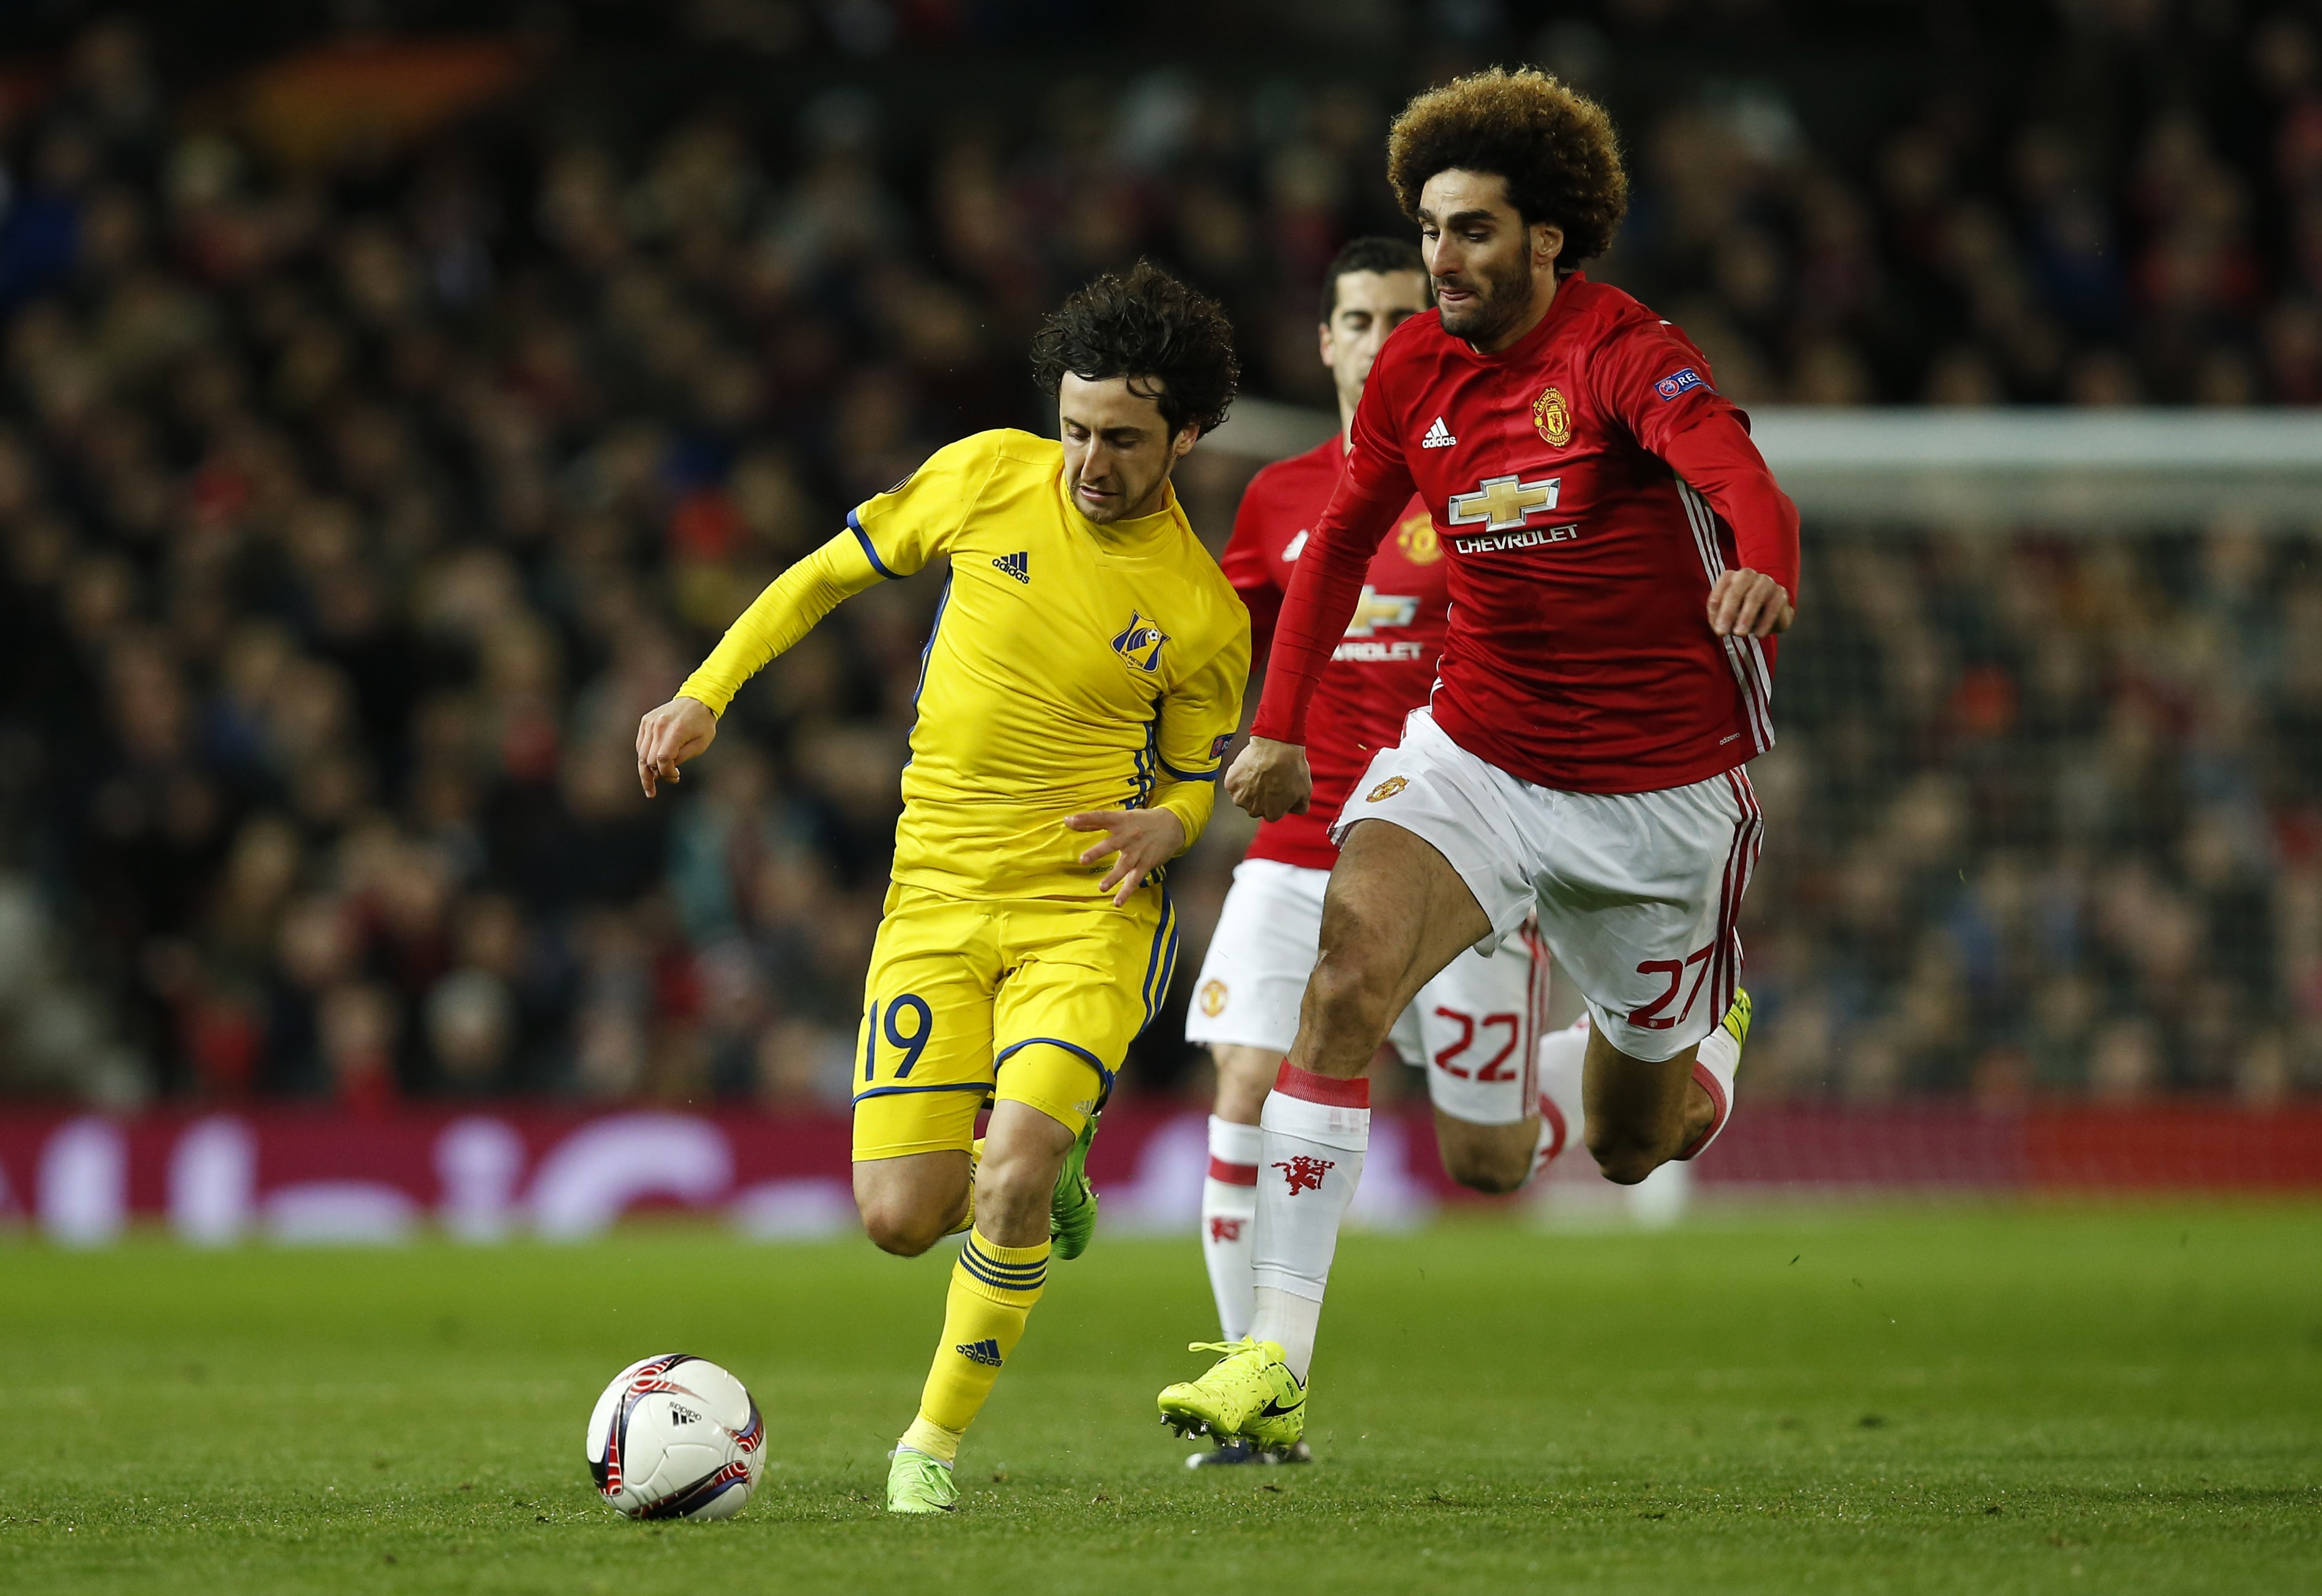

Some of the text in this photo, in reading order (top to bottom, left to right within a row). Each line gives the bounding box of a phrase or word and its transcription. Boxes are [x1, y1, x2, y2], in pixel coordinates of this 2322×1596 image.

[1422, 435, 1457, 449] adidas
[1547, 431, 1568, 442] UNITED
[1455, 524, 1578, 554] CHEVROLET
[991, 558, 1030, 584] adidas
[1628, 941, 1714, 1030] 27
[865, 994, 932, 1081] 19
[1435, 1006, 1519, 1081] 22
[956, 1345, 1003, 1367] adidas
[669, 1401, 702, 1421] adidas
